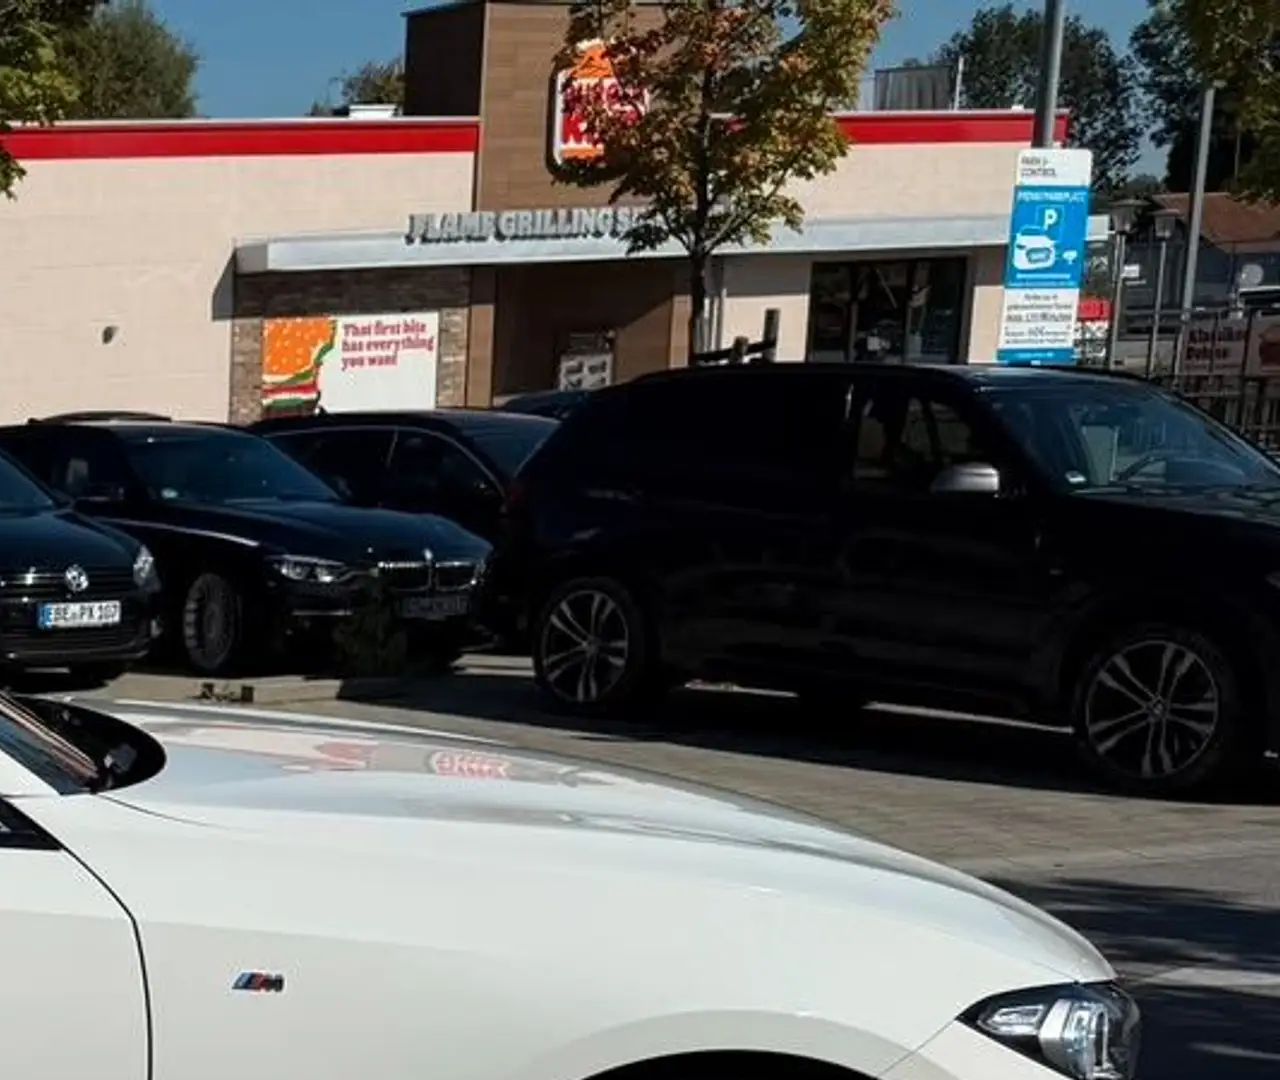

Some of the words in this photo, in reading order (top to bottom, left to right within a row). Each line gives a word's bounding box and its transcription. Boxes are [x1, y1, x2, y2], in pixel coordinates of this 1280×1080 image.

[406, 211, 495, 244] FLAME
[496, 207, 616, 241] GRILLING
[1043, 208, 1058, 231] P
[342, 322, 372, 337] That
[374, 321, 401, 335] first
[403, 319, 427, 334] bite
[341, 339, 364, 353] has
[366, 335, 434, 355] everything
[341, 355, 365, 371] you
[367, 353, 398, 367] want
